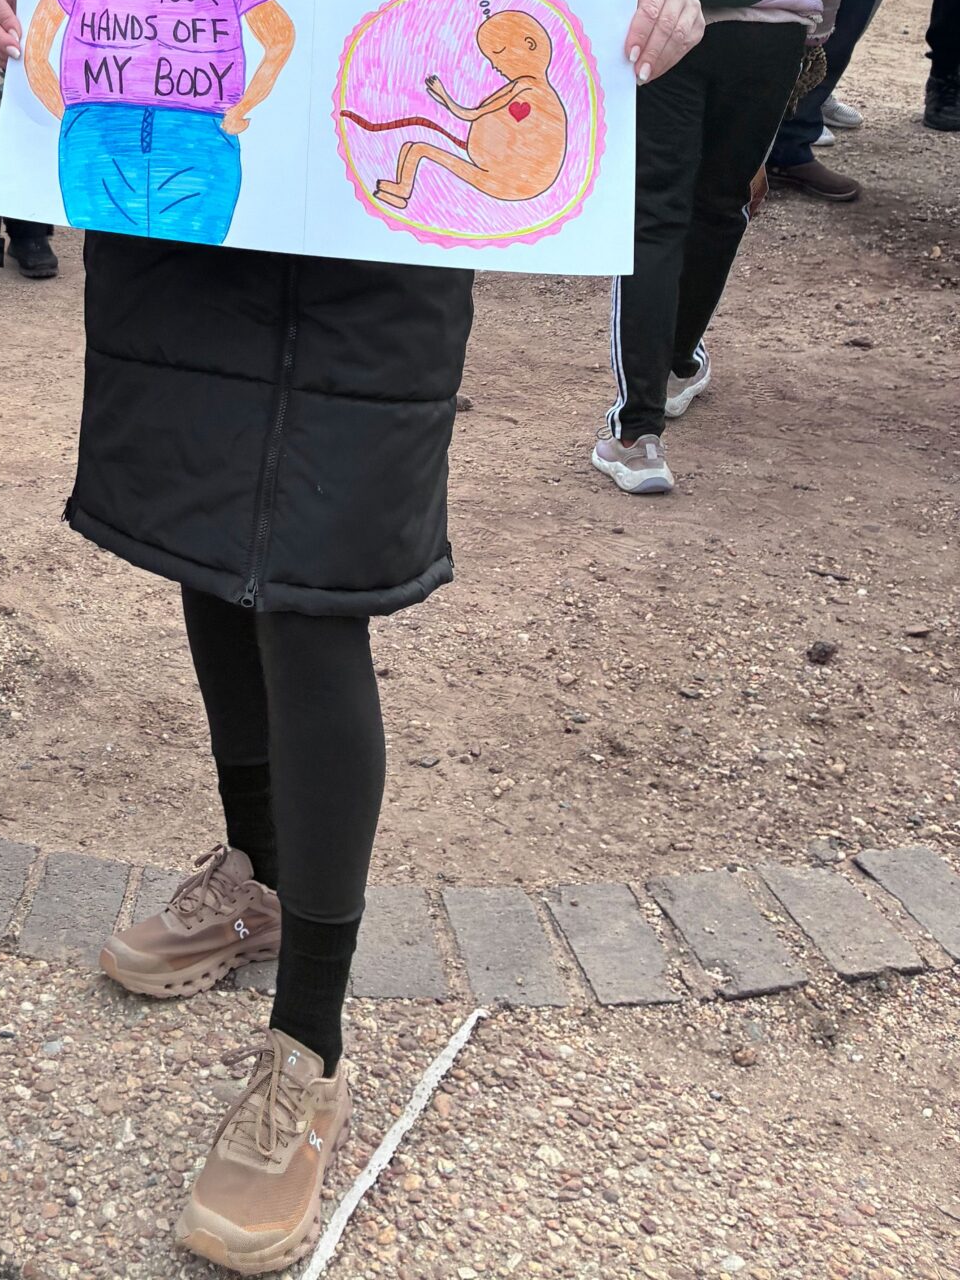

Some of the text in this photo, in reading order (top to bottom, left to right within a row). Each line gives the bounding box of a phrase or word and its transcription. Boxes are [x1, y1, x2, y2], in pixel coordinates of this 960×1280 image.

[80, 8, 230, 44] HANDS OFF
[84, 55, 235, 101] MY BODY
